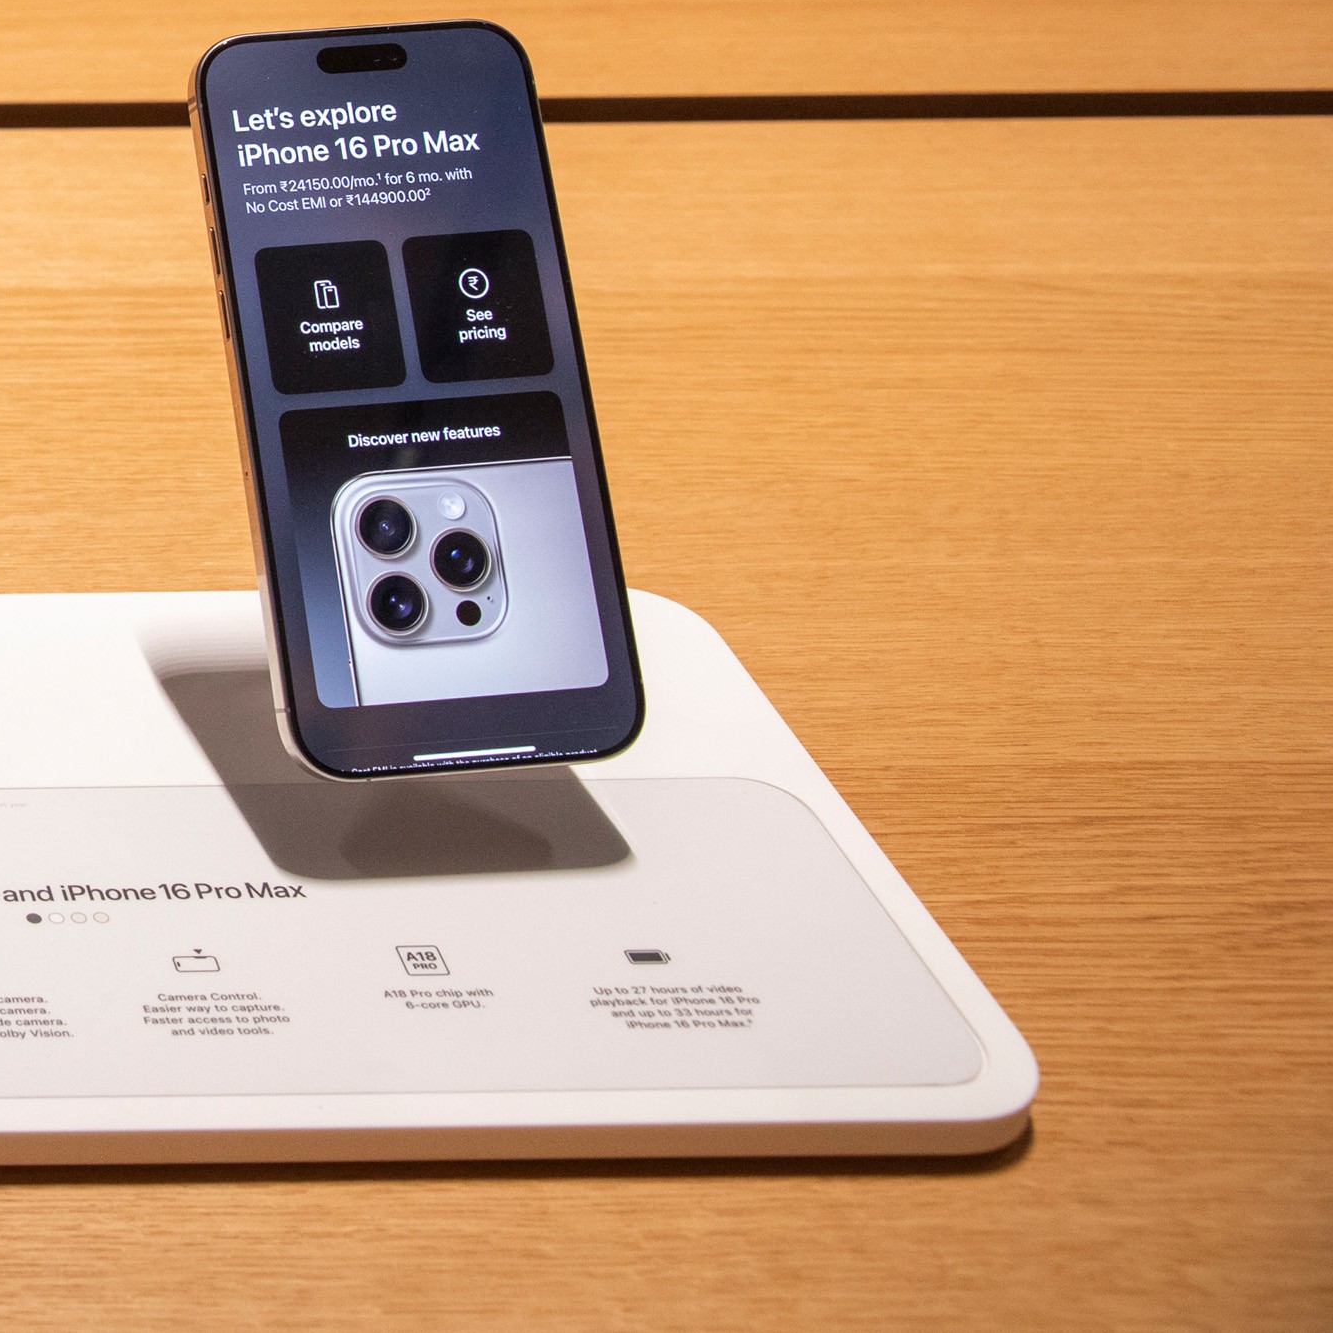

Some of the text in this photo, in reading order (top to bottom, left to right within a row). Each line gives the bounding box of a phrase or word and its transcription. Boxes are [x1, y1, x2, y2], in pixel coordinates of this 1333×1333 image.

[231, 100, 397, 132] Let's explore
[237, 129, 480, 168] iPhone 16 Pro Max
[242, 181, 277, 196] From
[383, 171, 403, 186] for
[405, 169, 415, 184] 6
[417, 171, 442, 183] mo.
[444, 165, 472, 181] with
[245, 200, 265, 214] No
[267, 197, 299, 213] Cost
[301, 194, 326, 210] EMI
[328, 196, 343, 208] or
[465, 307, 493, 322] See
[299, 319, 363, 336] Compare
[458, 324, 507, 344] pricing
[308, 334, 360, 352] models
[347, 425, 501, 448] Discover new features
[2, 882, 54, 902] and
[60, 882, 156, 901] iPhone
[158, 881, 190, 900] 16
[194, 880, 241, 899] Pro
[244, 880, 305, 898] Max
[406, 951, 437, 962] A18
[412, 962, 437, 970] PRO
